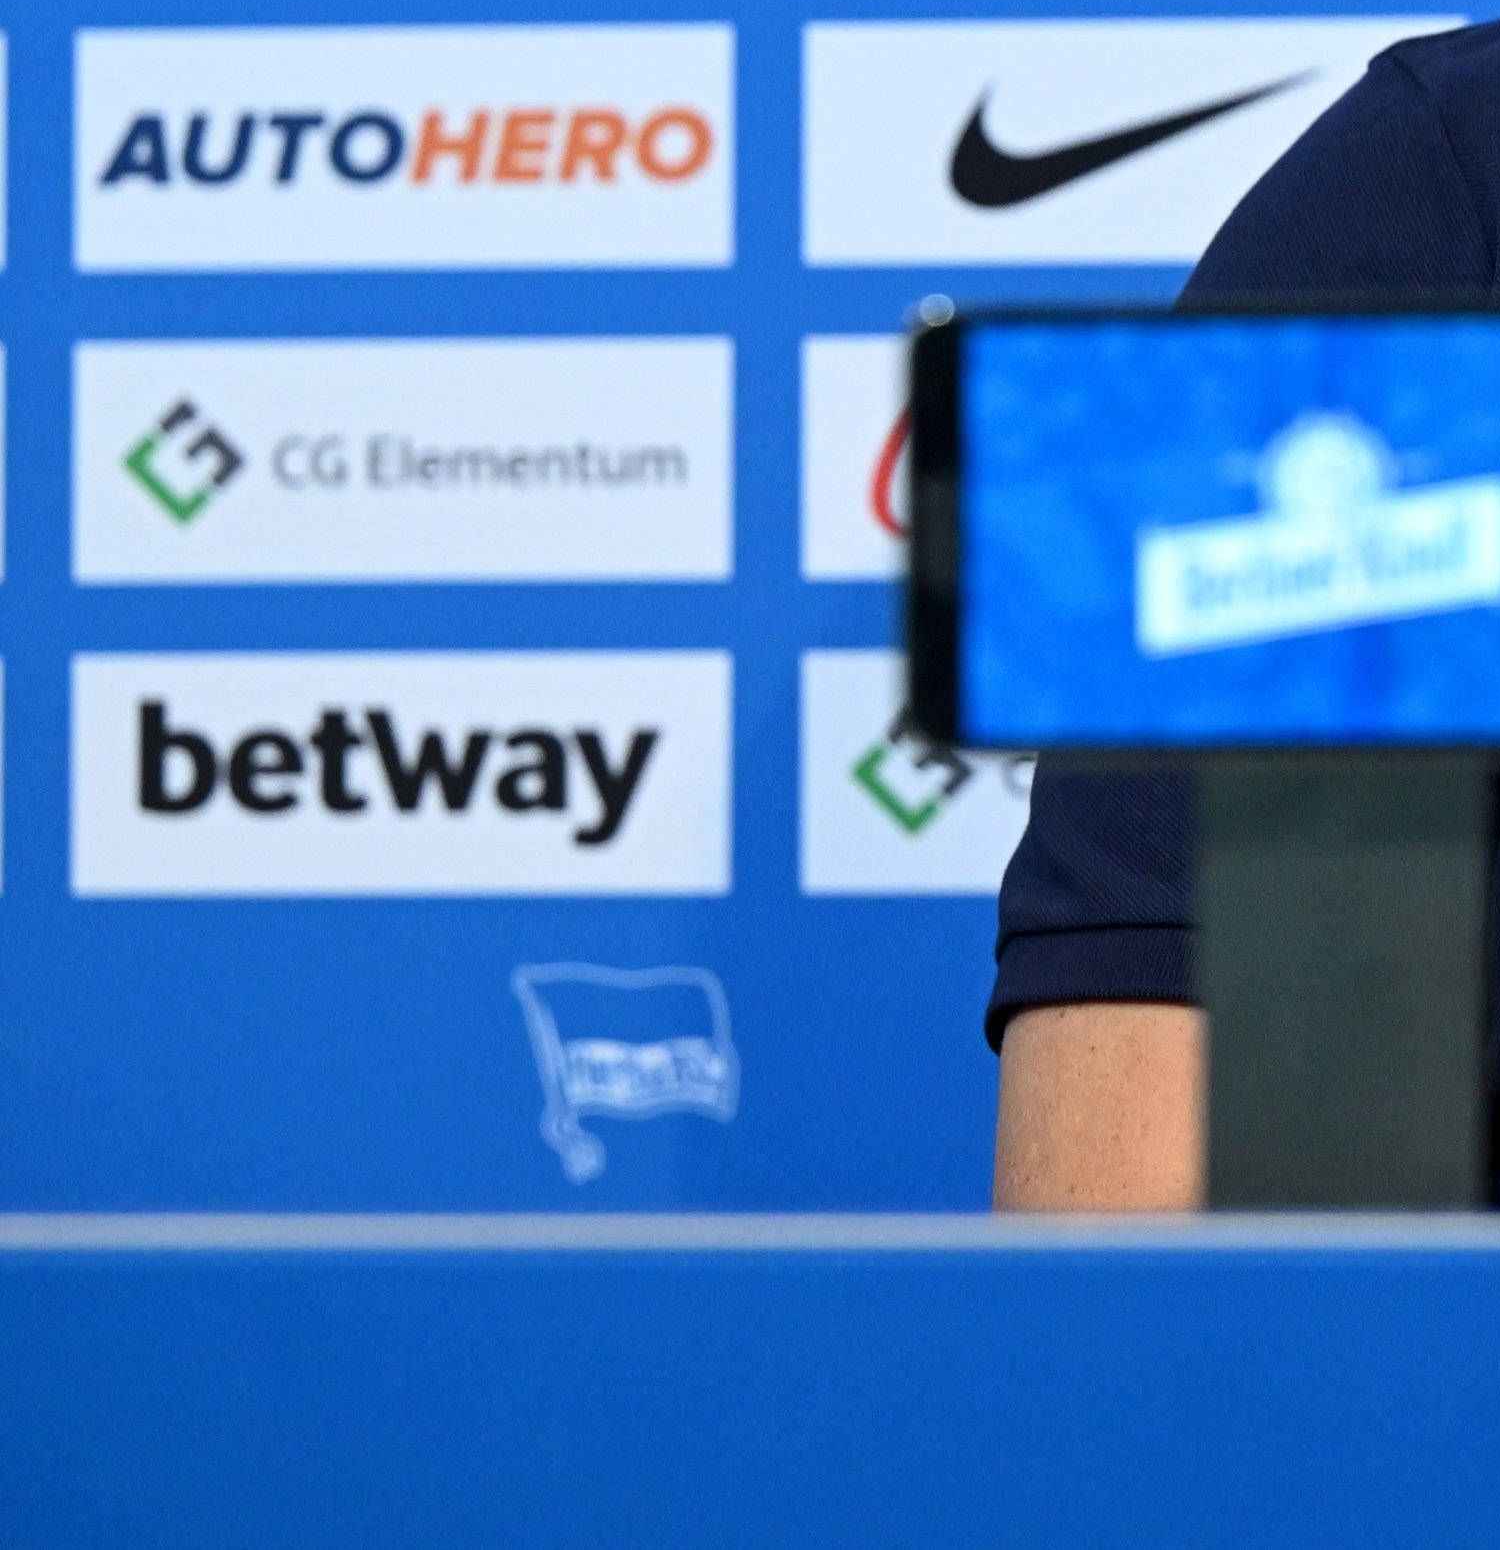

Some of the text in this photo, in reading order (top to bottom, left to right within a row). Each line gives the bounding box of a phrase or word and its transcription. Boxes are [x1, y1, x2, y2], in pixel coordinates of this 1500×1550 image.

[97, 107, 713, 190] AUTOHERO
[269, 432, 690, 493] CG Elementum
[136, 697, 662, 851] betway
